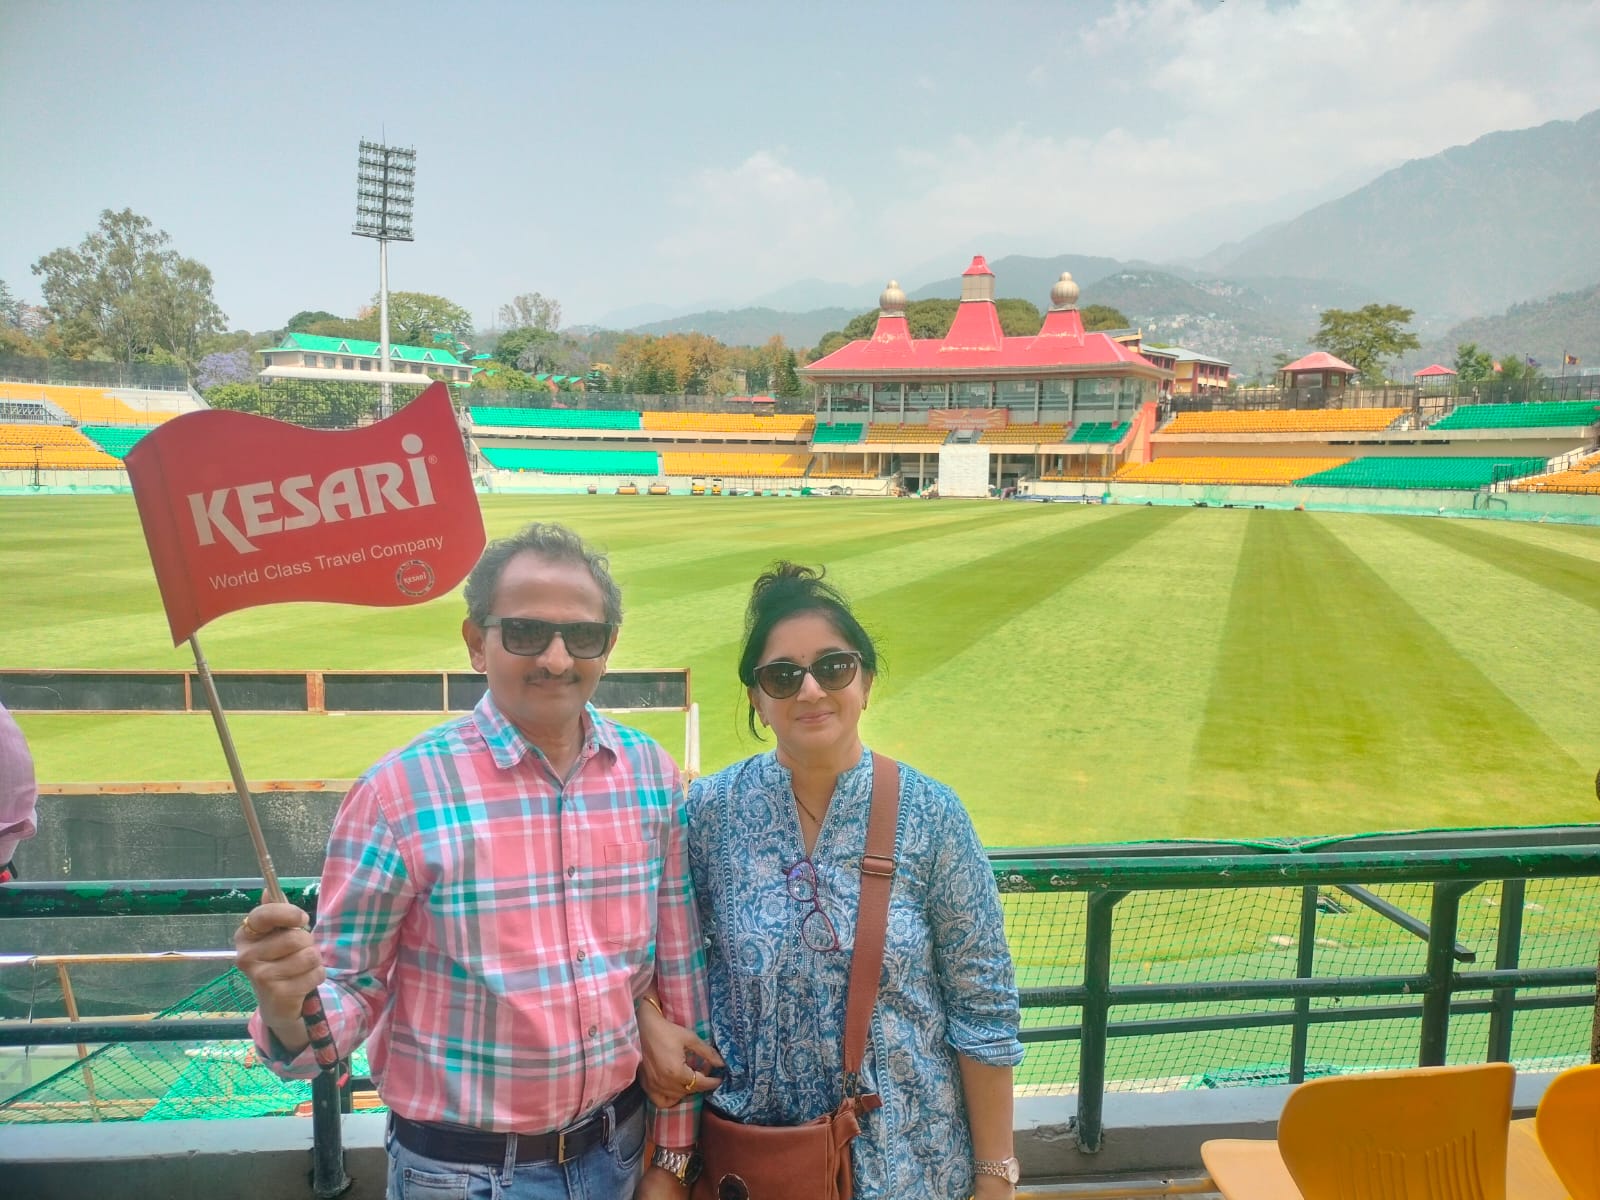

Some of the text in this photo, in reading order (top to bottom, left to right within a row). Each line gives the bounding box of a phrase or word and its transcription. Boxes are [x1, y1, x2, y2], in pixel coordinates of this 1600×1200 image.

[208, 535, 443, 590] World Class Travel Company
